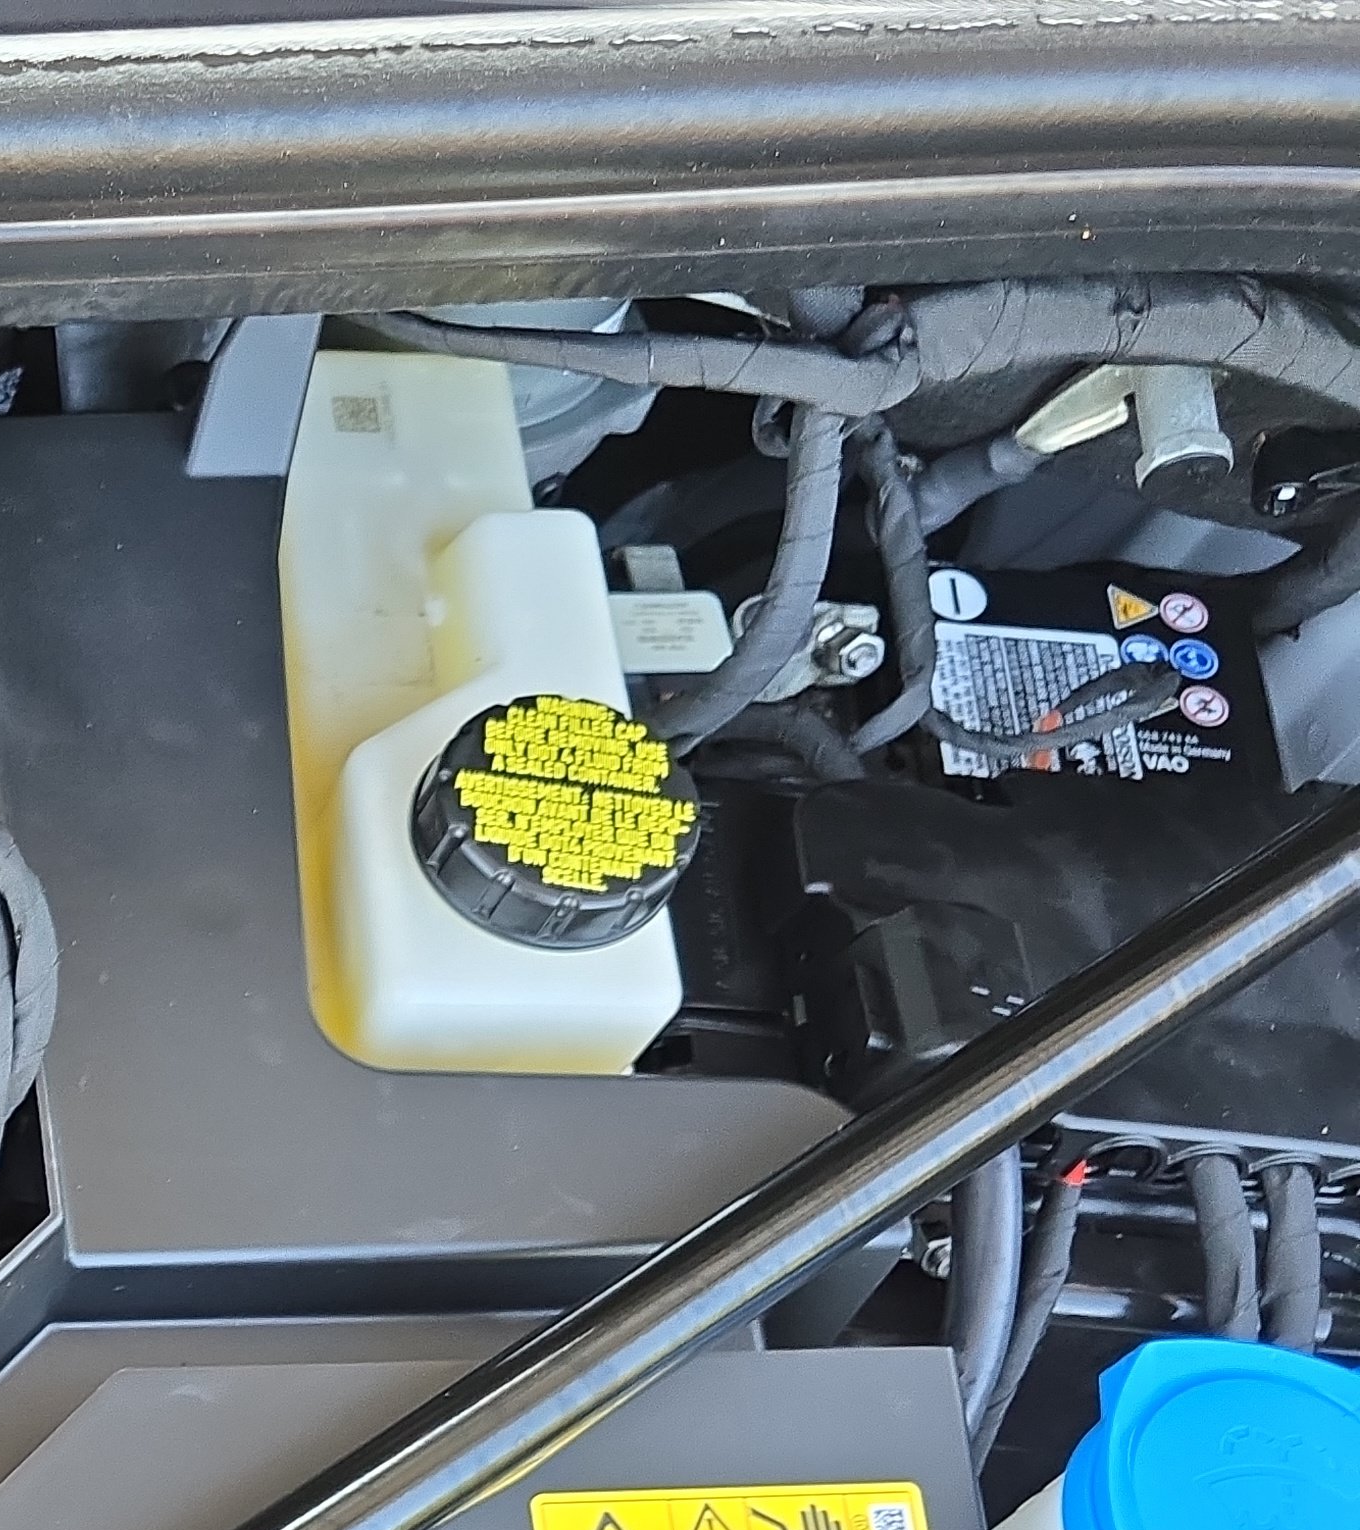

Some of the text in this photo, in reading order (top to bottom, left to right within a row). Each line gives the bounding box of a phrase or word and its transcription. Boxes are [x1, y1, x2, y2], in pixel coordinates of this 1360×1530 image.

[507, 707, 647, 741] CLEAN FILLER CAP
[485, 738, 669, 778] ONLY DOT 4 FLUID FROM
[635, 742, 667, 760] USE
[492, 755, 504, 771] A
[507, 757, 566, 778] SEALED
[1142, 754, 1190, 773] VAO
